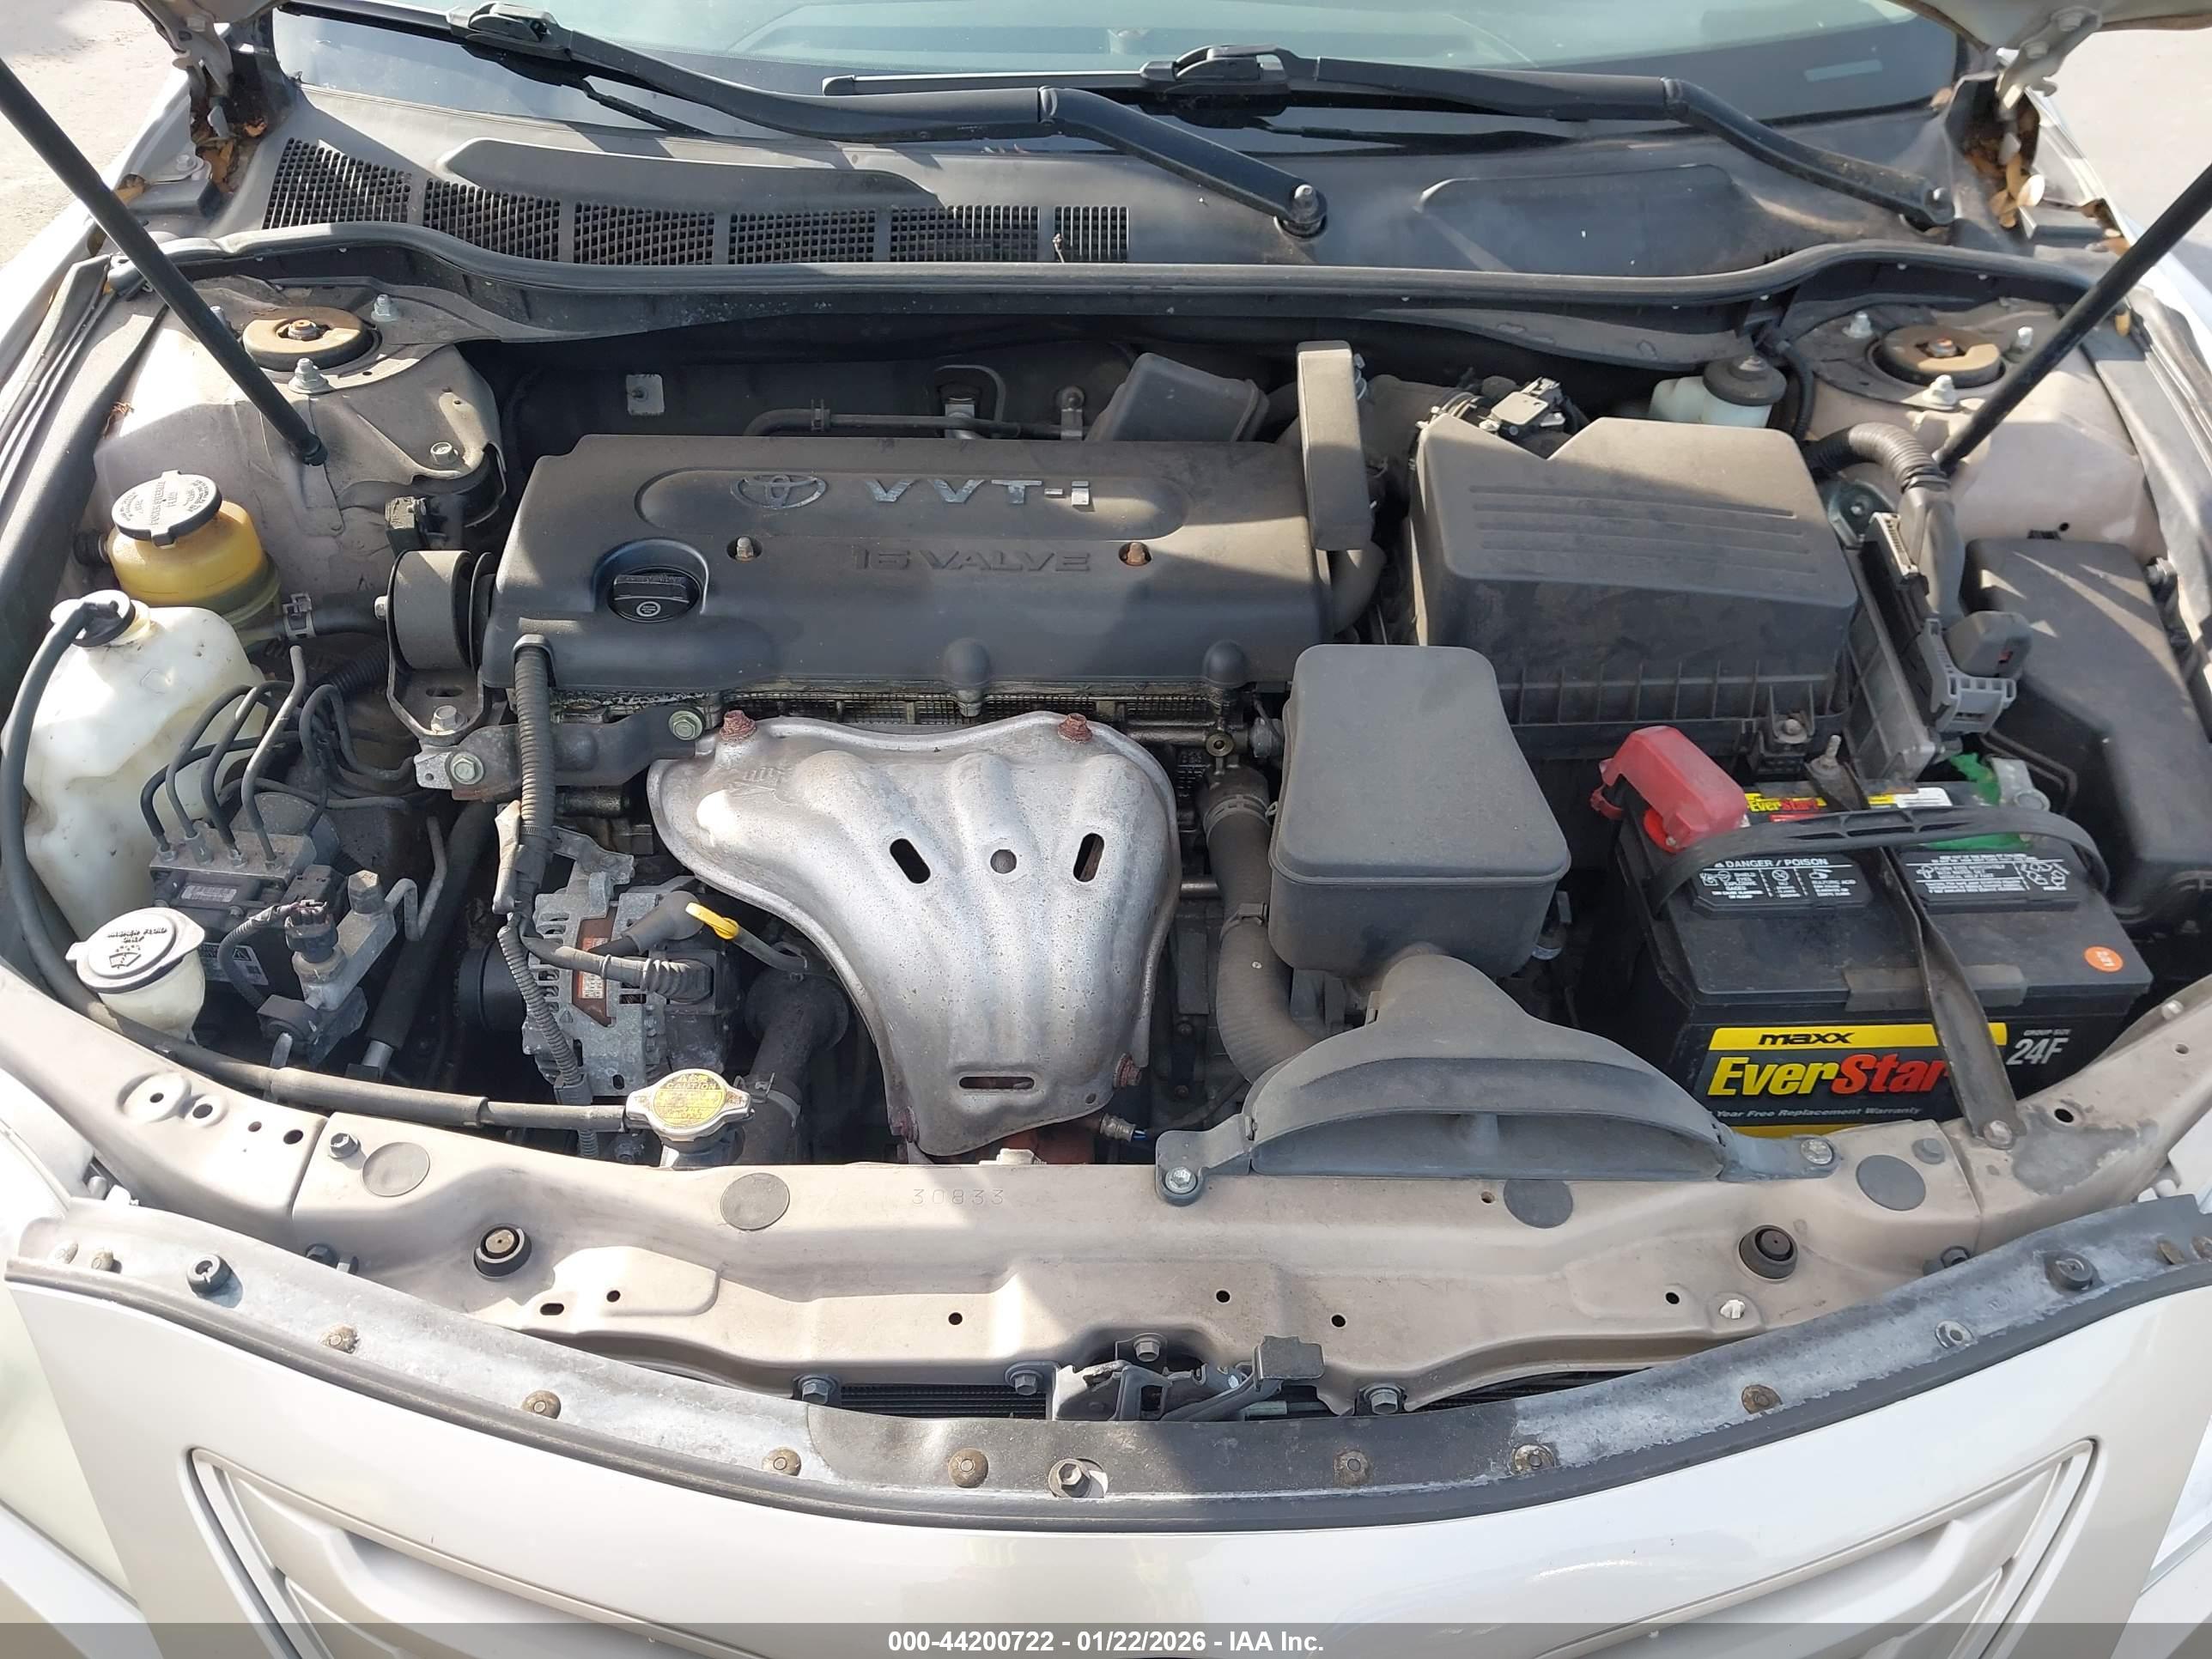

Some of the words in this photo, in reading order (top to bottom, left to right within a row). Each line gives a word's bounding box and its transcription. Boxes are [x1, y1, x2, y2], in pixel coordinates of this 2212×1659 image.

[865, 479, 1090, 505] VVT-i
[855, 549, 910, 569] 16
[919, 550, 1091, 571] VALVE
[1725, 860, 1773, 868] DANGER
[1759, 1032, 1856, 1046] maxx
[2006, 1037, 2069, 1066] 24F
[1707, 1053, 1949, 1097] EverStar
[1717, 1109, 1743, 1118] Year
[1778, 1108, 1862, 1117] Replacement
[1865, 1107, 1923, 1115] Warranty
[912, 1188, 1004, 1205] 30833
